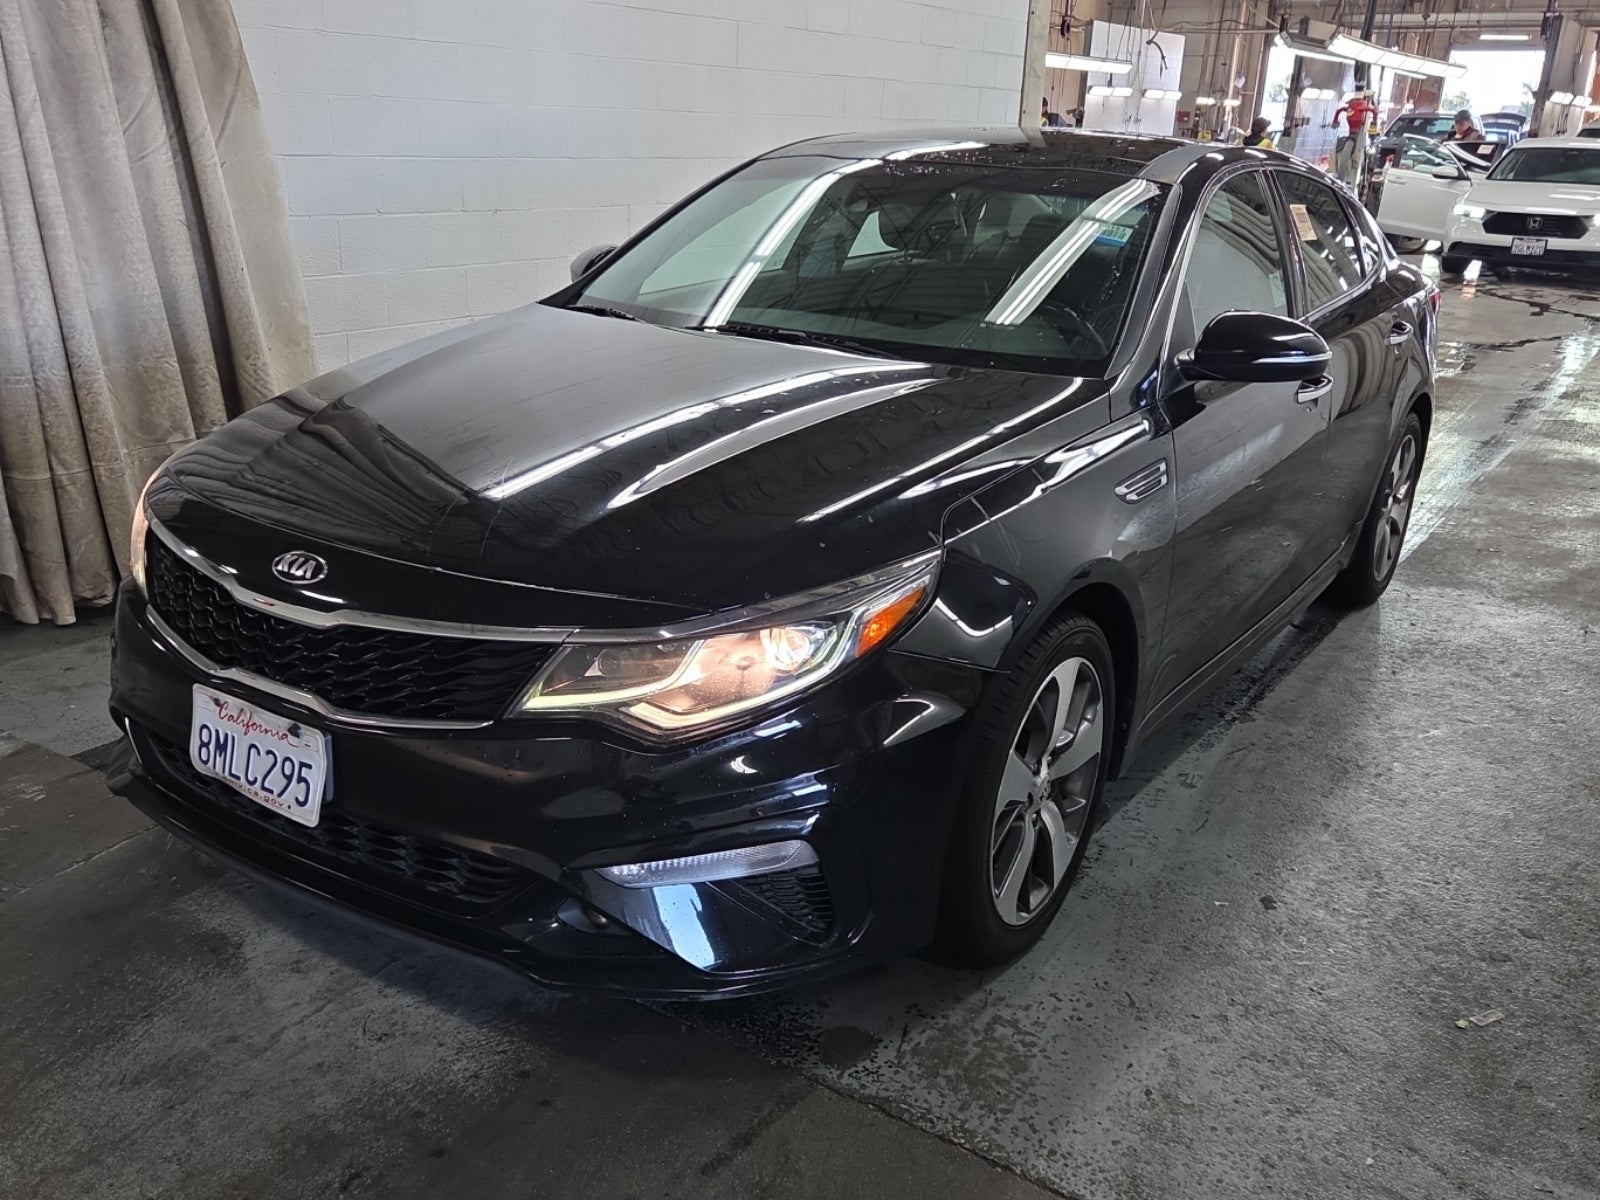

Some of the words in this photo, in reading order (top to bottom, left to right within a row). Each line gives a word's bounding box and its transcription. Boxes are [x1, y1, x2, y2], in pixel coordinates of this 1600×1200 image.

[275, 554, 317, 580] KIA
[218, 700, 299, 748] California
[198, 723, 313, 808] 8MLC295
